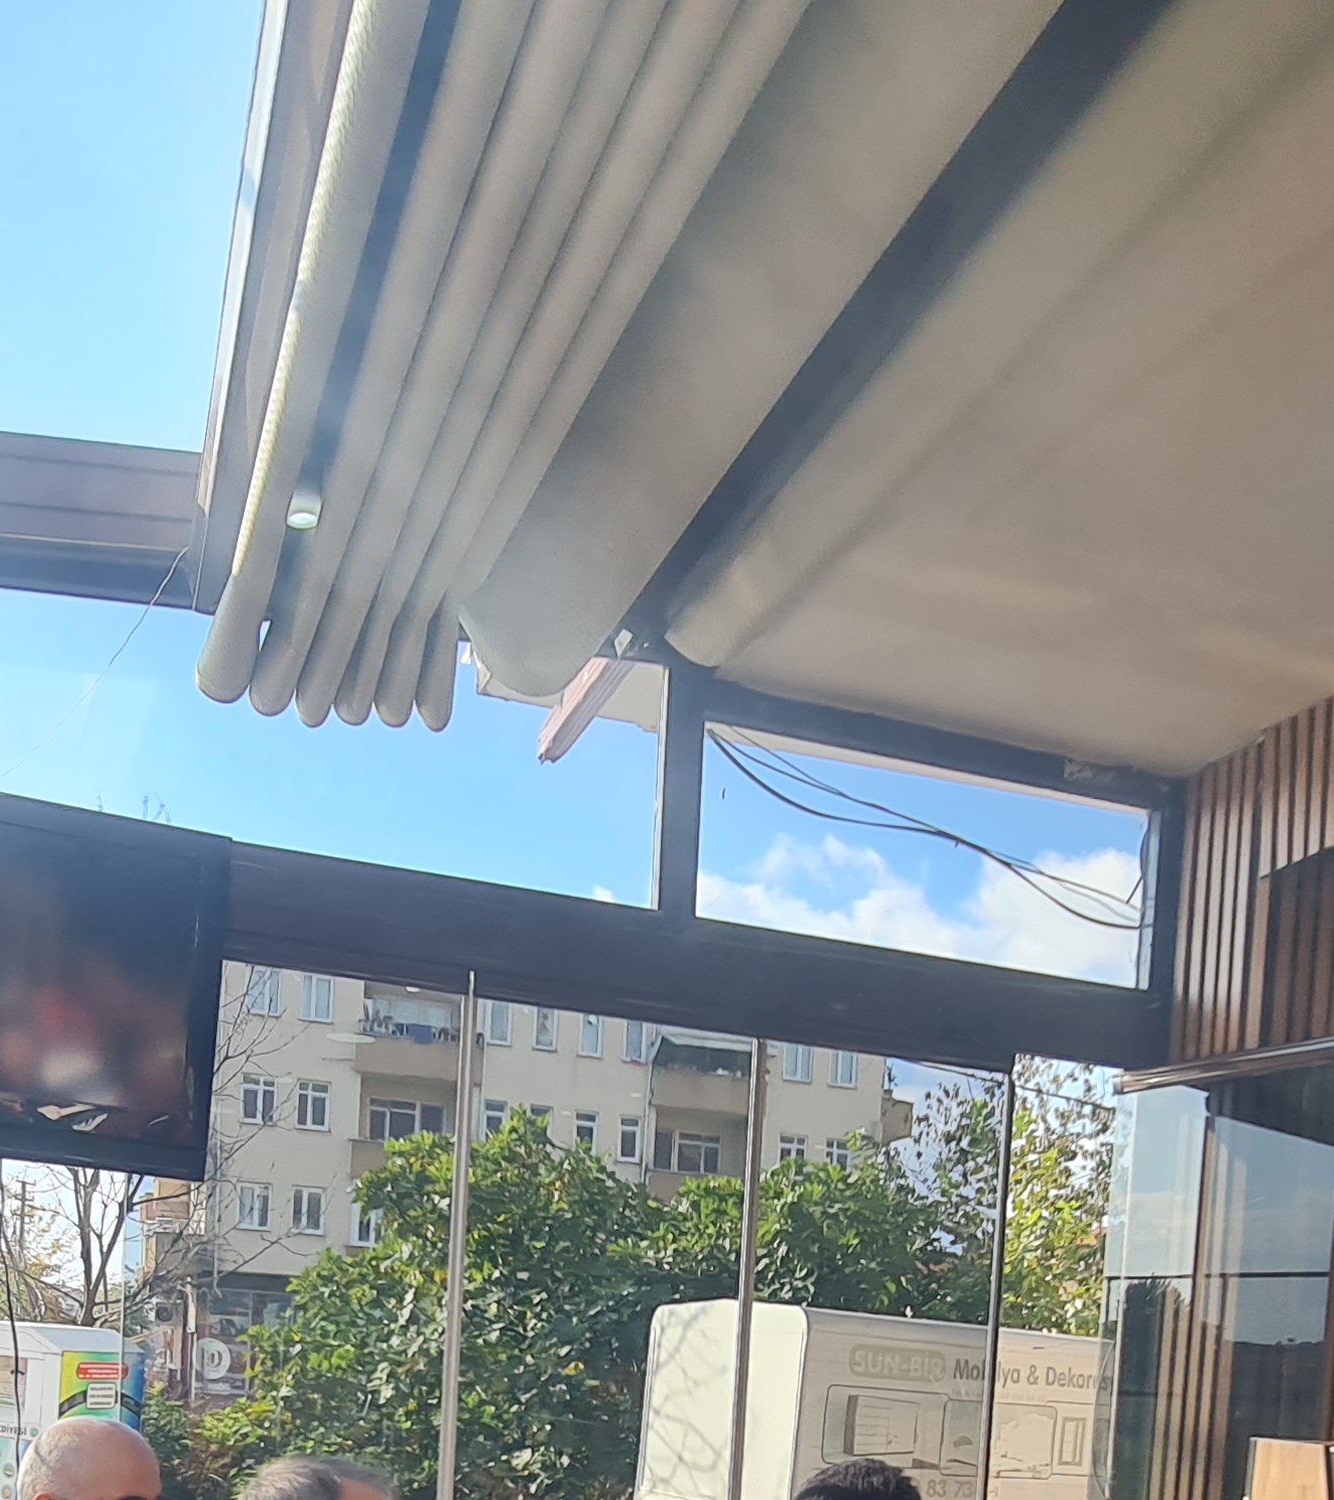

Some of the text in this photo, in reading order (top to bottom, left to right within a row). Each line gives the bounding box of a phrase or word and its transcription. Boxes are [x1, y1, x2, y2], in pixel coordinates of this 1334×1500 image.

[953, 1358, 1021, 1388] Molya
[1026, 1363, 1040, 1386] &
[926, 1479, 947, 1498] 83
